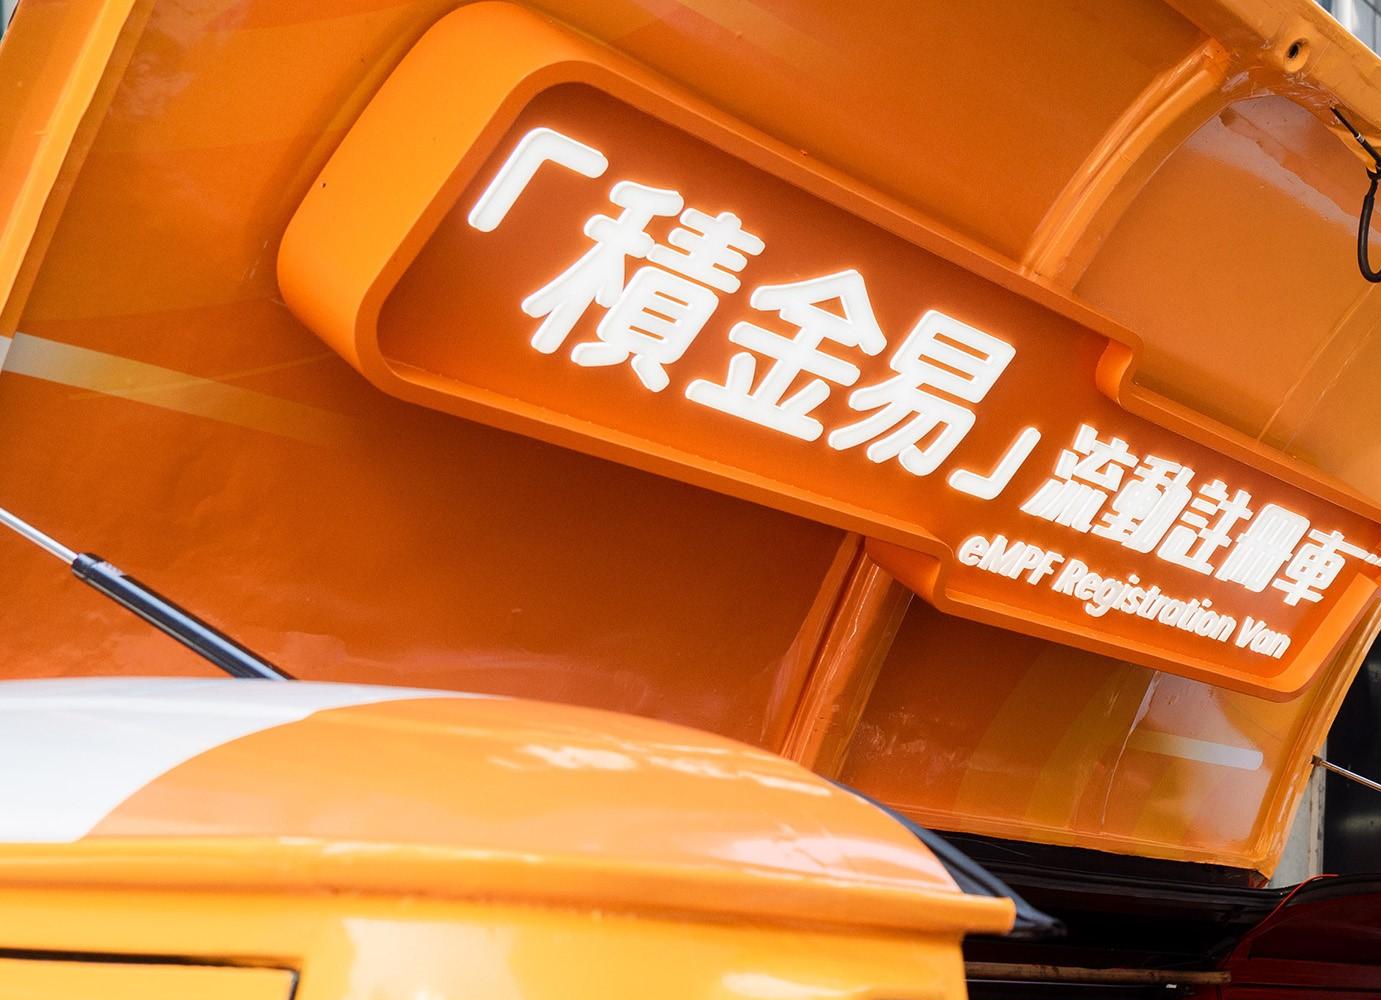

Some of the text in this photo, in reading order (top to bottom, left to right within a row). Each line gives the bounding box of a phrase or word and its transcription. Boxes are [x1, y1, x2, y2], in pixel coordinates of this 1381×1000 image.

[957, 533, 1293, 660] eMPF Registration Van
